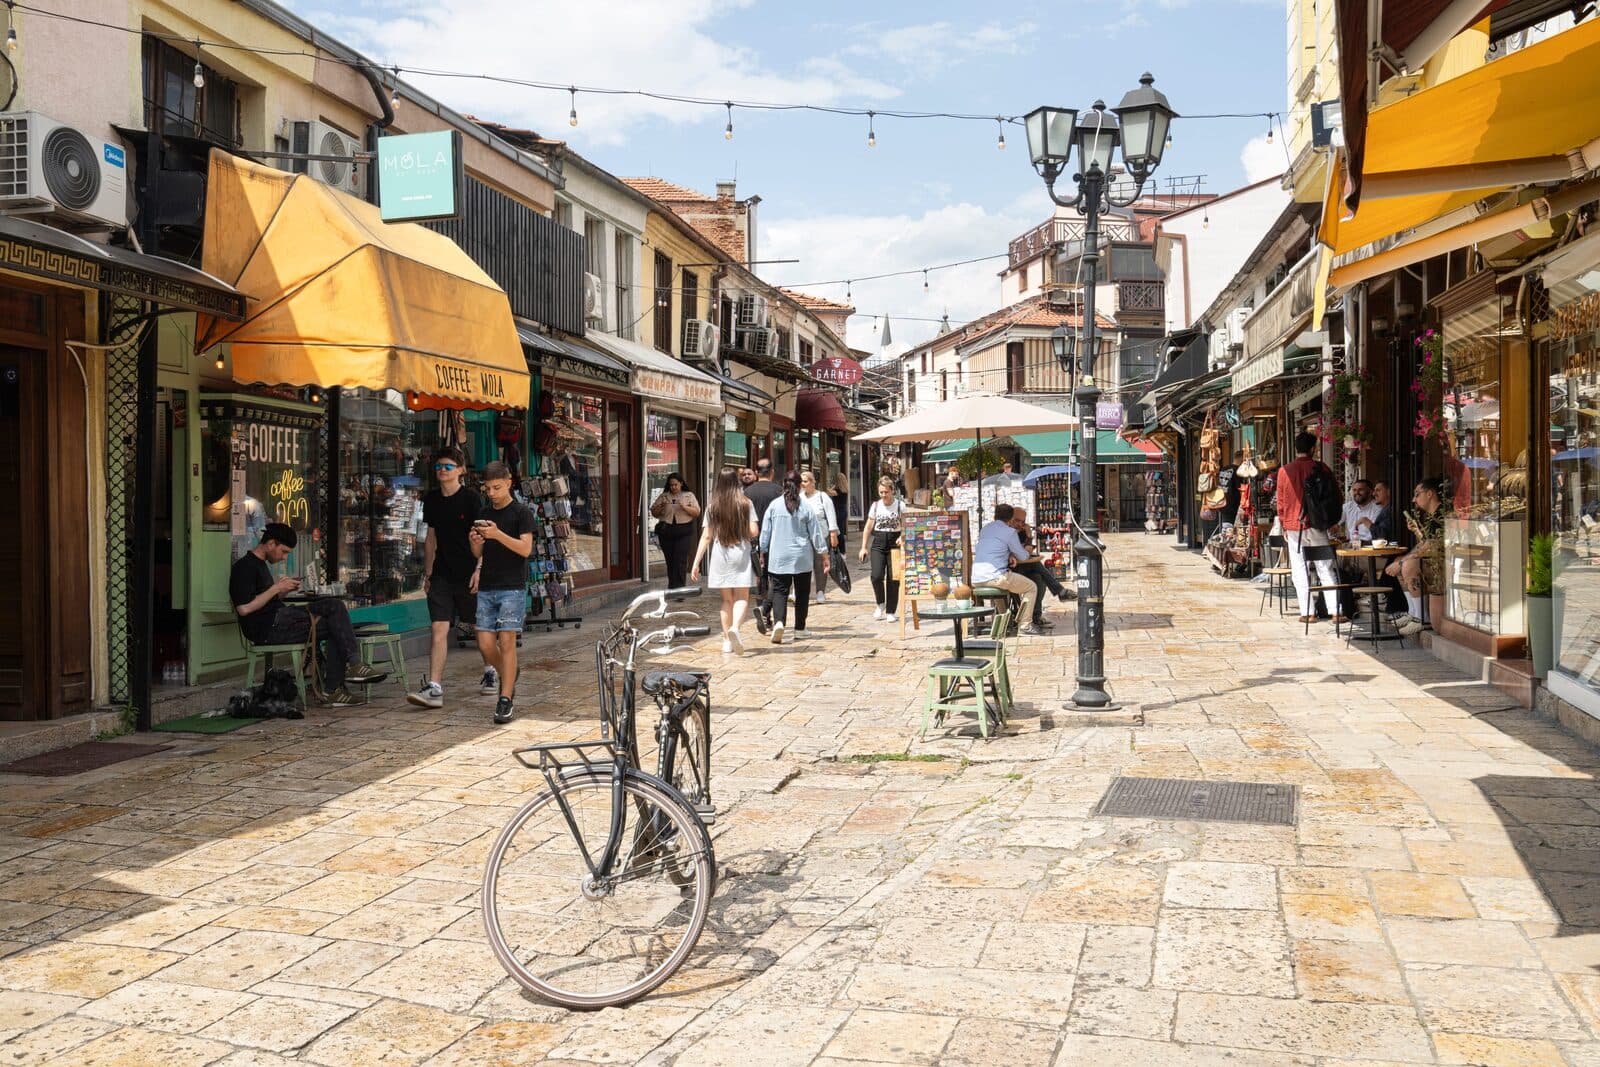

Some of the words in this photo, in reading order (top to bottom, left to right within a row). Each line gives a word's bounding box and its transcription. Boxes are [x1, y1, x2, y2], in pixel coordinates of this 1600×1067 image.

[384, 151, 447, 172] MOLA
[435, 363, 472, 394] COFFEE
[480, 372, 505, 399] MOLA
[816, 368, 857, 380] GARNET
[249, 423, 300, 465] COFFEE
[270, 469, 304, 501] coffee
